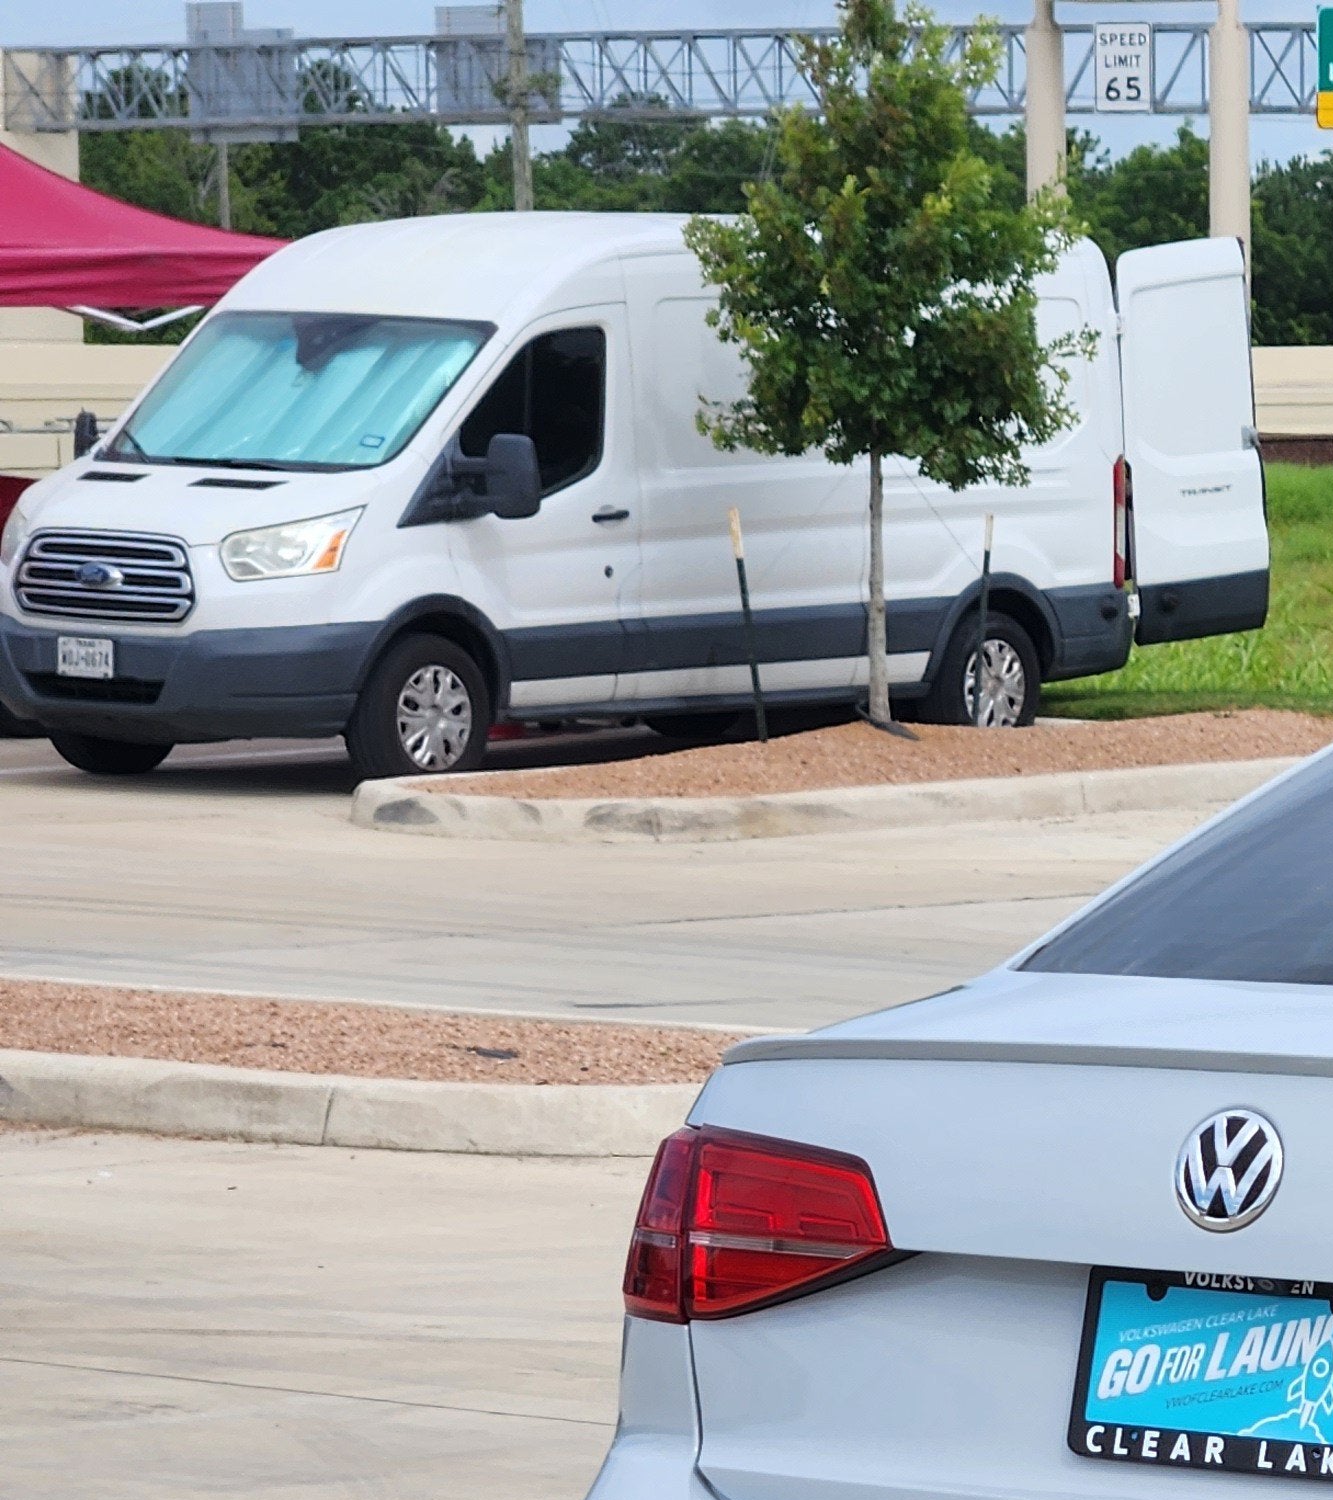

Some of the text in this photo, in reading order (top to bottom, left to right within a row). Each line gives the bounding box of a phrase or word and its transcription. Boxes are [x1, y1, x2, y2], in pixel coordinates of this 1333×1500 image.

[1099, 32, 1147, 46] SPEED
[1104, 54, 1142, 68] LIMIT
[1105, 76, 1141, 101] 65
[1119, 1304, 1280, 1342] VOLKSWAGEN CLEAR LAKE
[1097, 1344, 1160, 1399] GO
[1155, 1342, 1206, 1385] FOR
[1086, 1424, 1226, 1464] CLEAR
